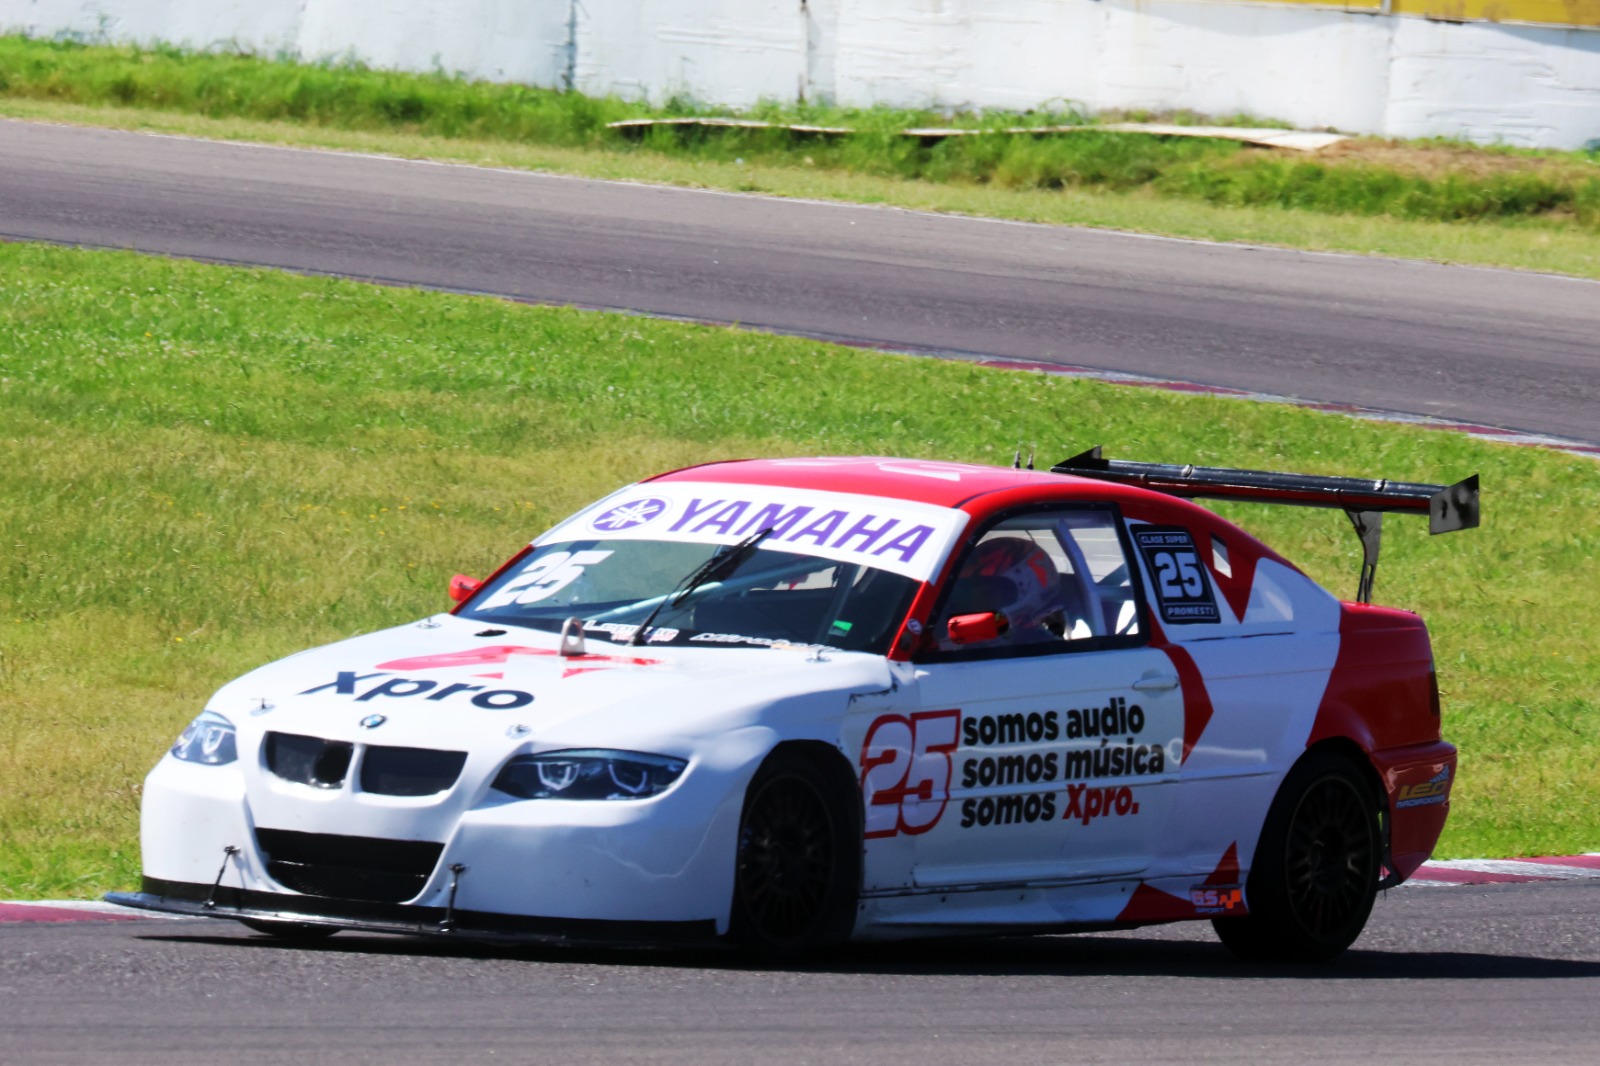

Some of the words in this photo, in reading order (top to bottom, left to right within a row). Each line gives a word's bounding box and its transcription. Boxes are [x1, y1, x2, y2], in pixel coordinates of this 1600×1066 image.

[668, 498, 935, 562] YAMAHA
[475, 549, 614, 611] 25
[1155, 552, 1203, 598] 25
[296, 671, 535, 709] Xpro
[963, 709, 1058, 746] somos
[1066, 697, 1145, 738] audio
[860, 709, 961, 839] 25
[962, 752, 1058, 788] somos
[1064, 738, 1165, 779] música
[960, 793, 1056, 828] somos
[1062, 783, 1139, 826] Xpro.
[1398, 780, 1448, 801] LEO
